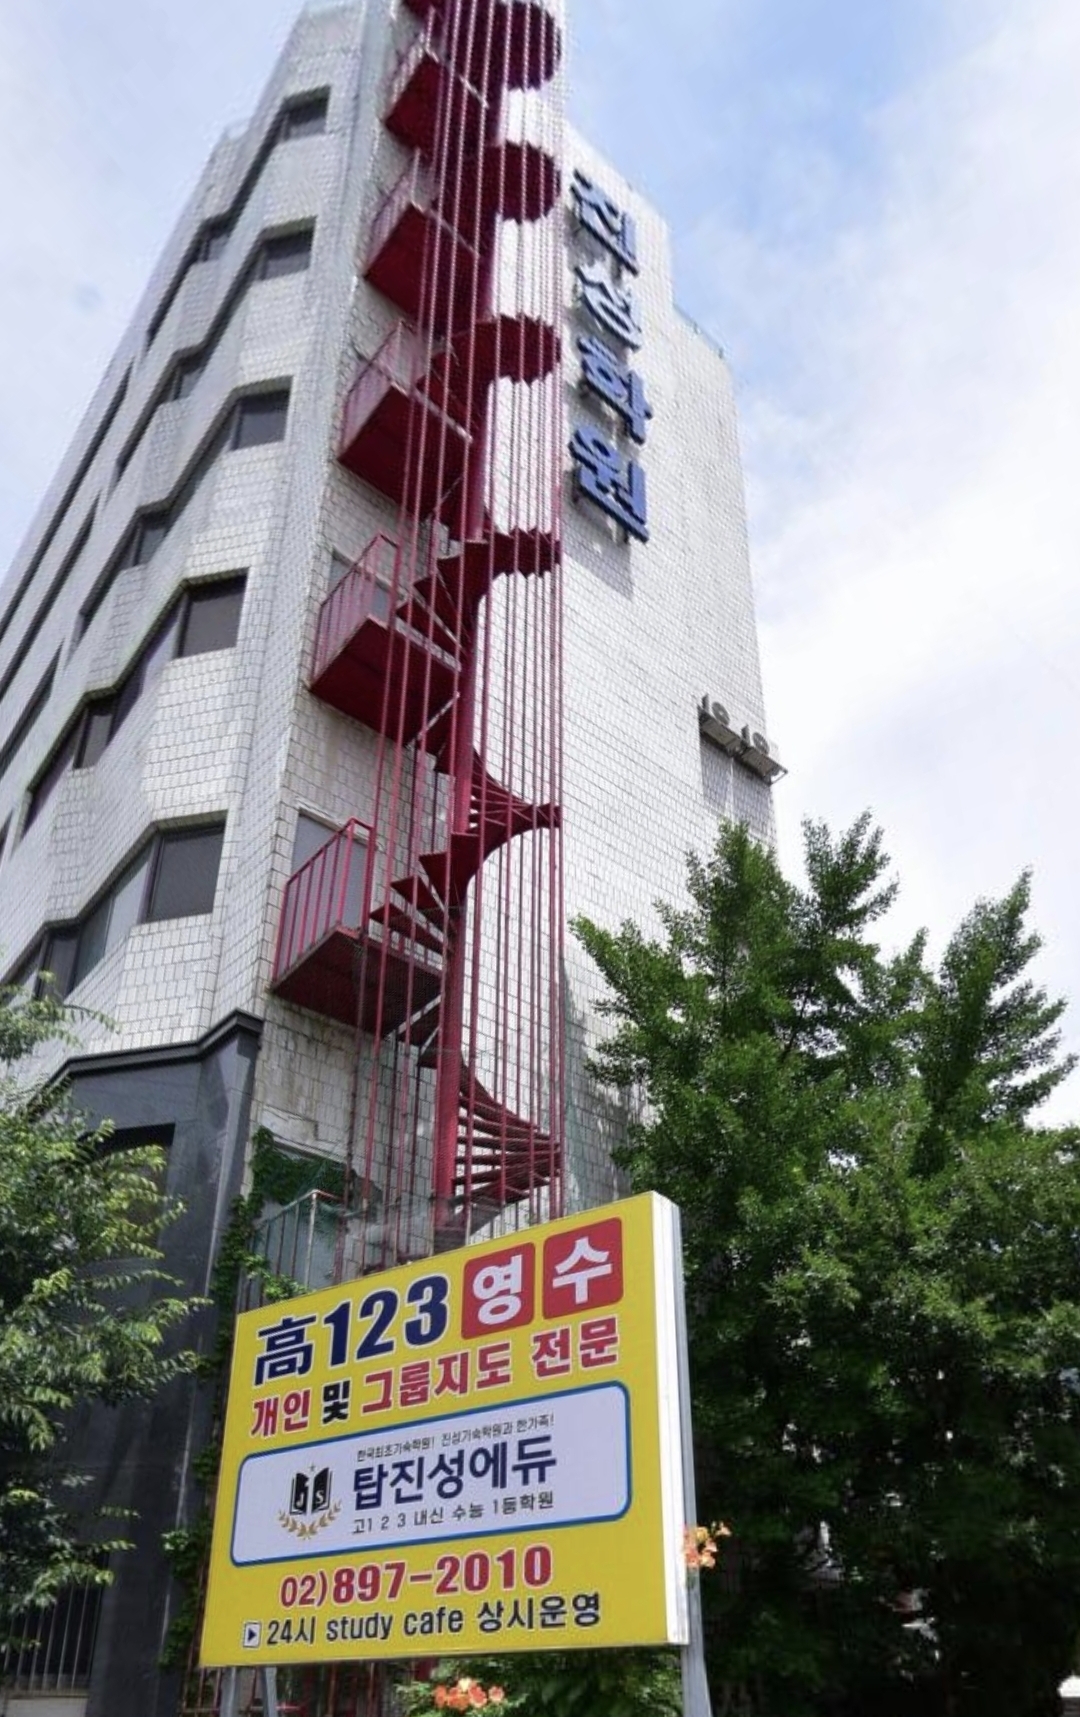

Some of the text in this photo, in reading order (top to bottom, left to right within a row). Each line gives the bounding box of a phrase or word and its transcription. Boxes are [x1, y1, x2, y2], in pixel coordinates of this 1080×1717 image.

[254, 1275, 448, 1384] 高123
[252, 1317, 619, 1436] 개인 및 그룹지도 전문
[442, 1421, 513, 1447] 진성기숙학원과
[517, 1414, 554, 1433] 한가족!
[353, 1435, 556, 1510] 탑진성에듀
[414, 1507, 444, 1525] 내신
[453, 1502, 484, 1520] 수능
[493, 1491, 554, 1515] 1등학원
[281, 1546, 551, 1607] 02)897-2010
[267, 1592, 600, 1645] 24시 study cafe 상시운영
